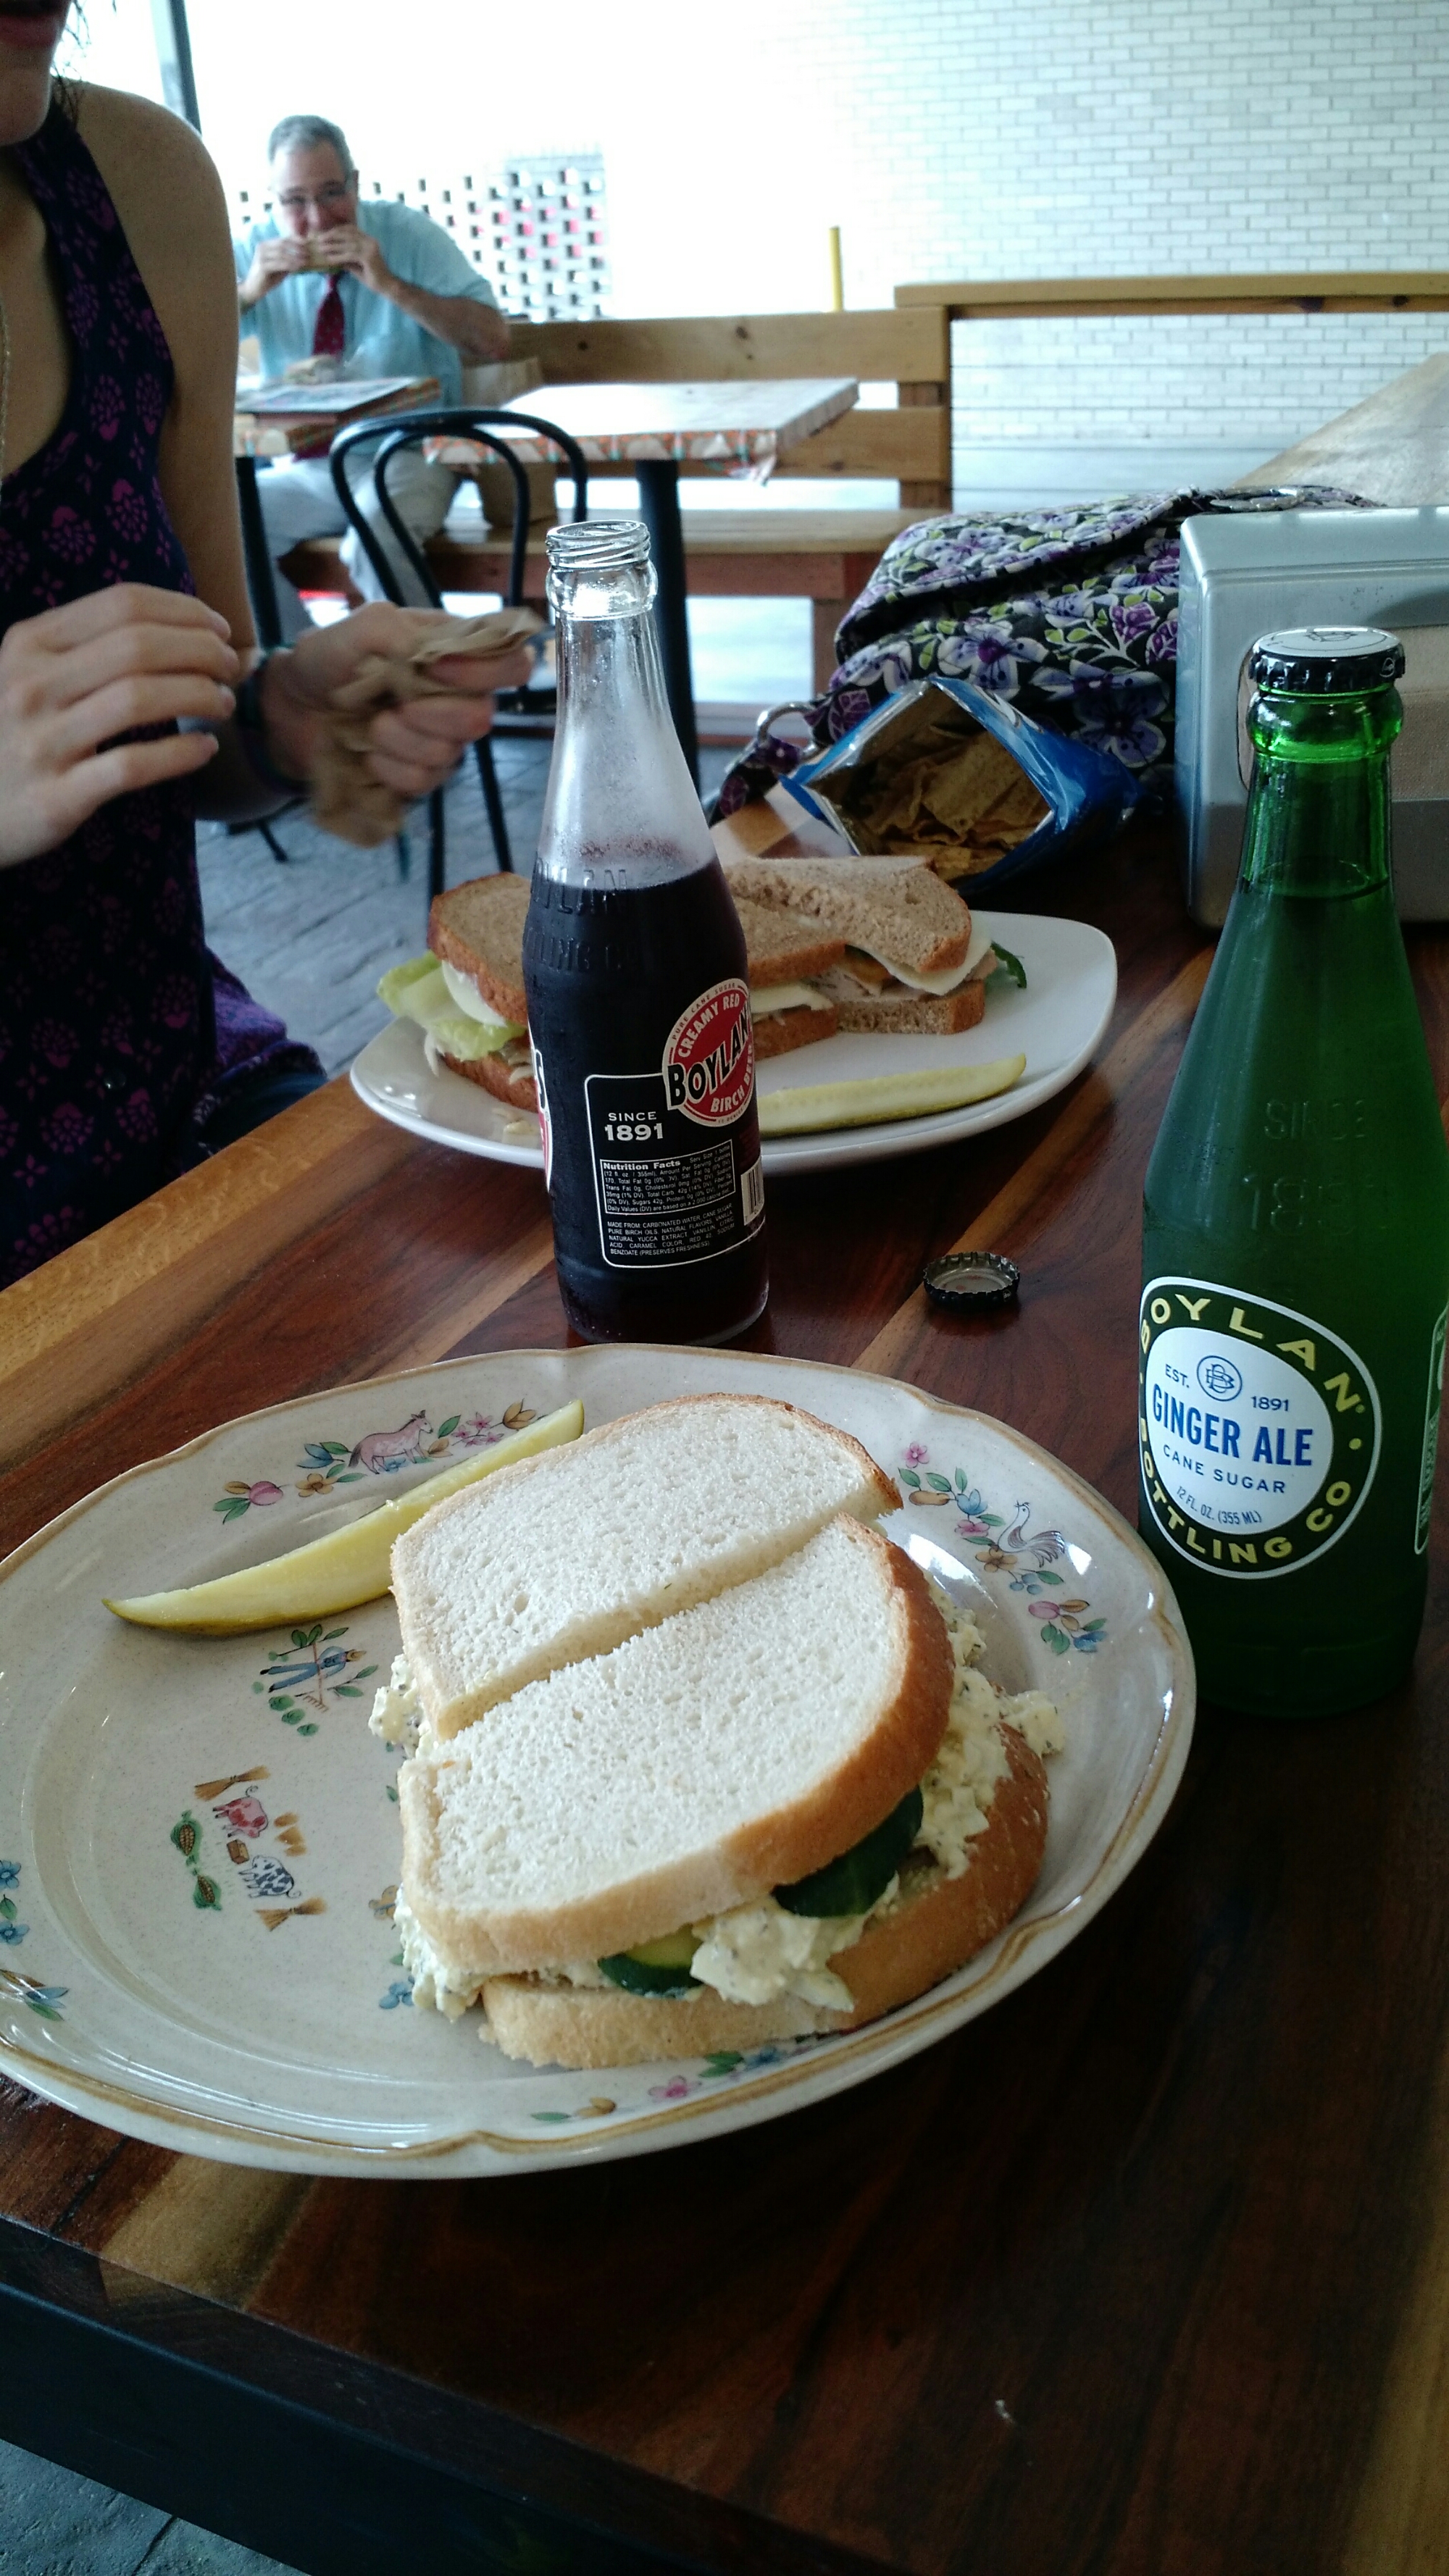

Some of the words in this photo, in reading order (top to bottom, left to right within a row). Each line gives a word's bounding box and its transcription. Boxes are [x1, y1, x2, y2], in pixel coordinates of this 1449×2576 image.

[672, 1016, 688, 1040] PURE
[691, 995, 709, 1013] CANE
[715, 982, 735, 995] SUGAR
[678, 1001, 718, 1058] CREAMY
[723, 993, 740, 1011] RED
[710, 1085, 746, 1113] BIRCH
[608, 1111, 656, 1121] SINCE
[604, 1124, 664, 1141] 1891
[653, 1161, 680, 1169] Facts
[693, 1161, 711, 1169] Serving
[714, 1152, 730, 1162] Calories
[717, 1166, 731, 1175] Sodium
[706, 1192, 720, 1200] calorie
[643, 1219, 680, 1228] CARBONATED
[703, 1210, 716, 1218] CANE
[715, 1210, 732, 1221] VANILLA
[719, 1216, 734, 1226] CITRIC
[717, 1223, 735, 1234] SODIUM
[640, 1247, 675, 1256] (PRESERVES
[676, 1240, 710, 1253] FRESHNESS)
[1165, 1363, 1190, 1388] EST.
[1250, 1396, 1289, 1411] 1891
[1152, 1384, 1240, 1458] GINGER
[1252, 1426, 1314, 1466] ALE
[1164, 1444, 1204, 1475] CANE
[1214, 1469, 1285, 1494] SUGAR
[1177, 1486, 1186, 1500] 12
[1186, 1494, 1197, 1512] FL.
[1200, 1504, 1214, 1520] OZ.
[1218, 1510, 1241, 1525] (355
[1242, 1510, 1262, 1524] ML)
[1306, 1481, 1351, 1532] CO
